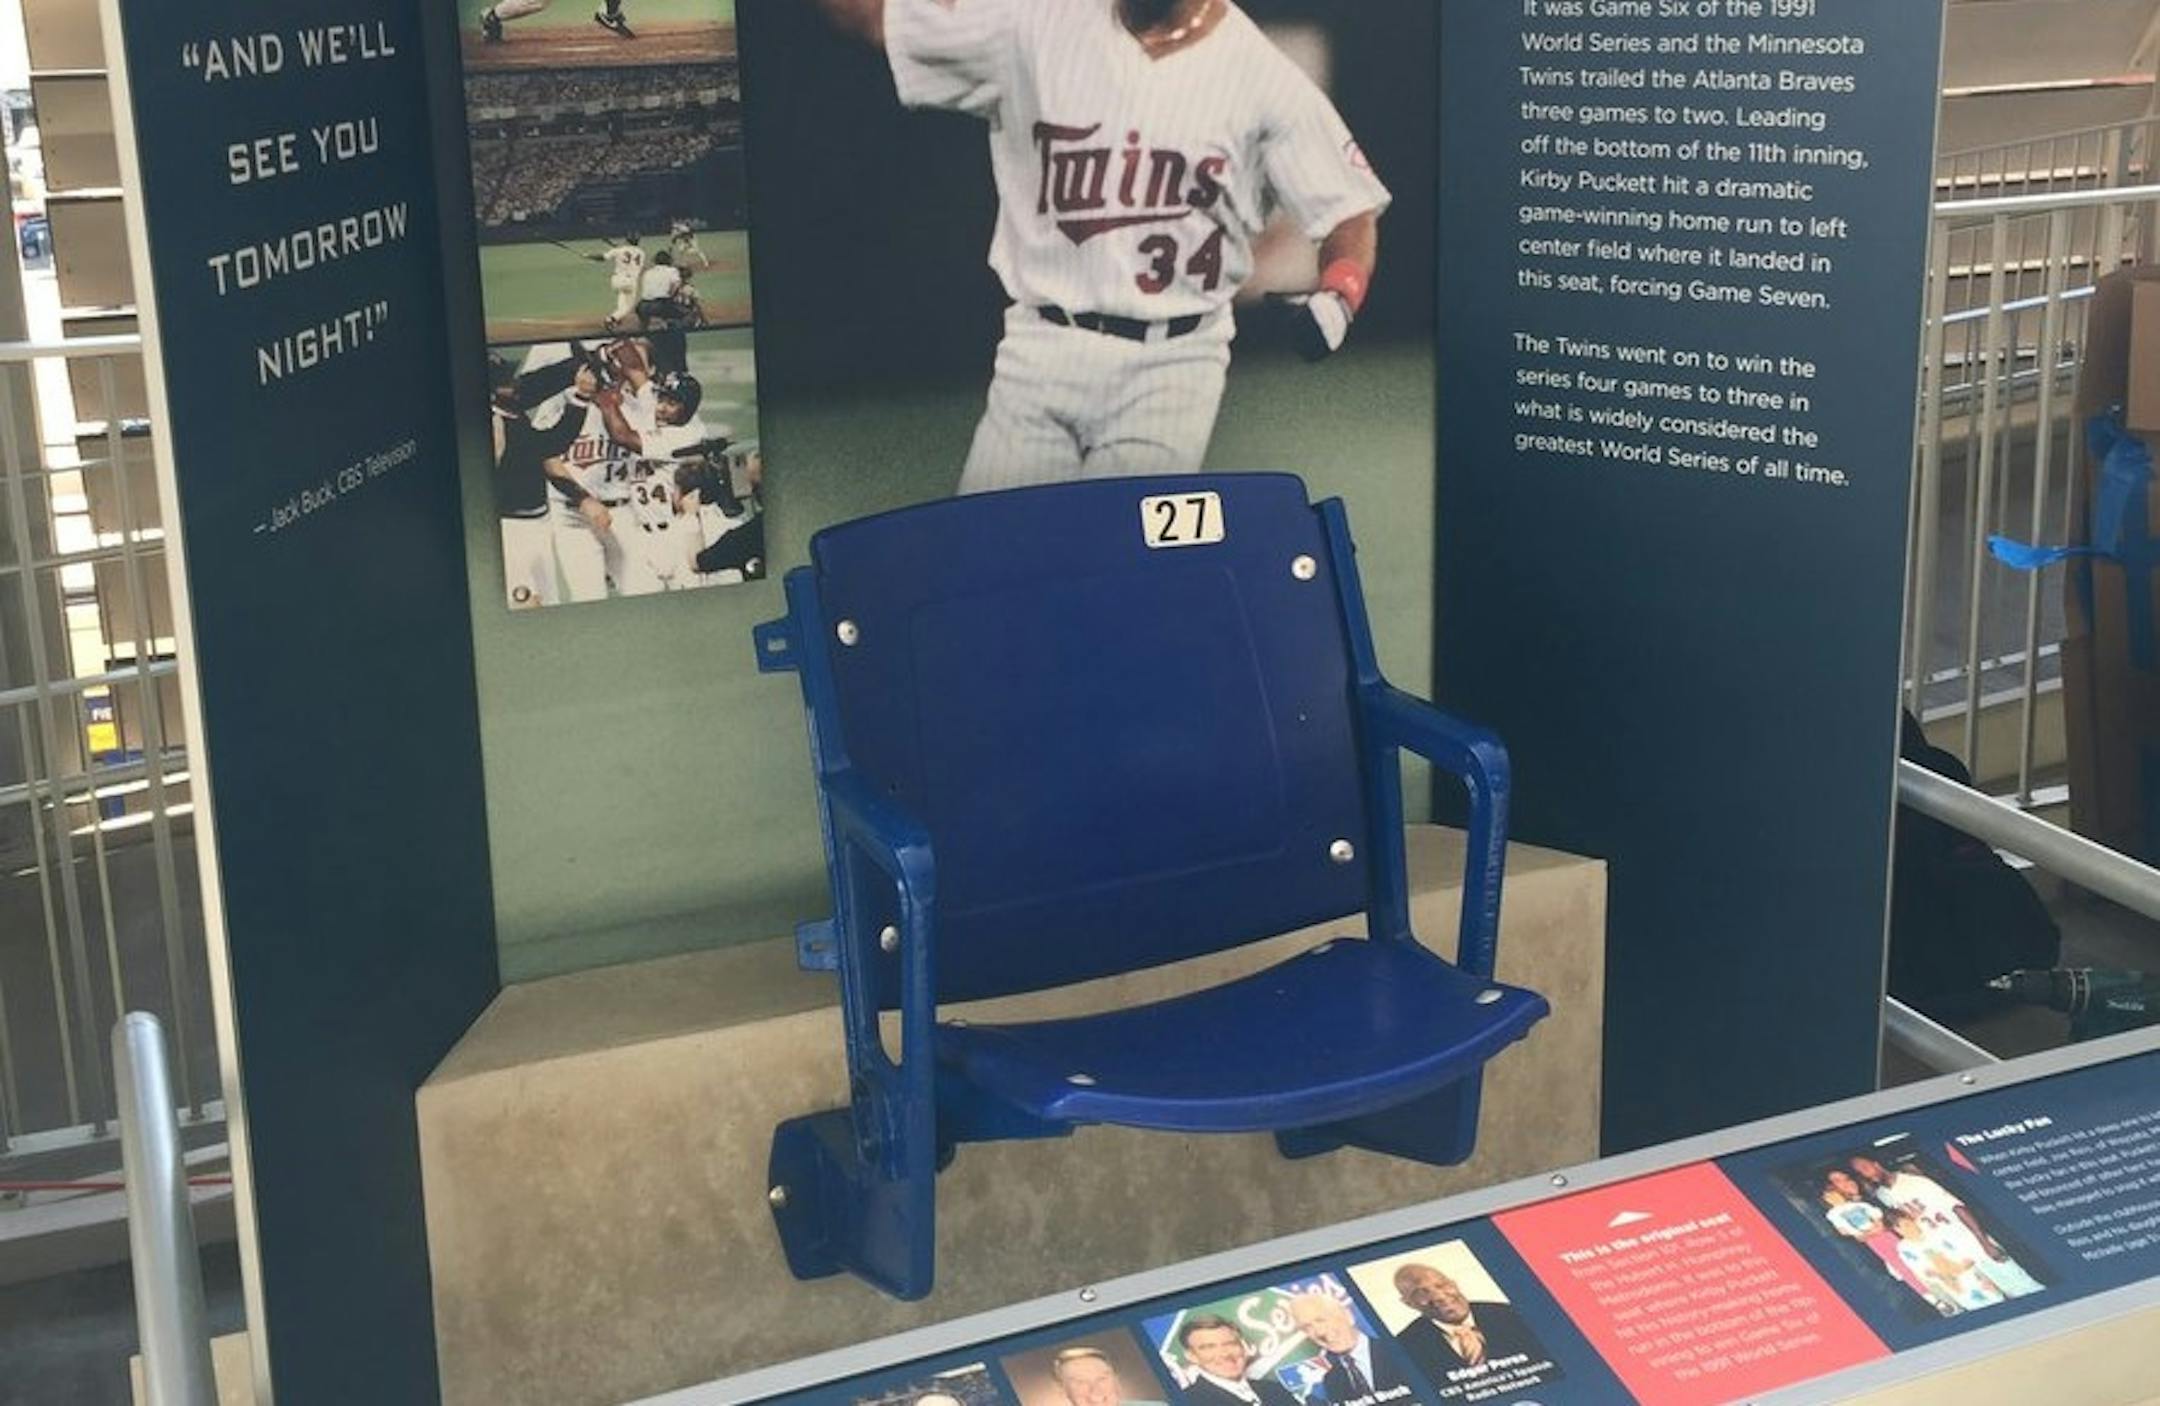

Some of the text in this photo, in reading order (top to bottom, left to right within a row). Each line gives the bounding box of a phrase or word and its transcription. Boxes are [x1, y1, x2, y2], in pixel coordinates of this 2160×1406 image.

[1523, 0, 1816, 17] It was Game Six of the 1991
[1521, 32, 1865, 55] World Series and the Minnesota
[1520, 66, 1856, 92] Twins trailed the Atlanta Braves
[1520, 102, 1826, 131] three games to two. Leading
[228, 116, 379, 185] SEE YOU
[1033, 121, 1226, 214] Twins
[1521, 136, 1869, 170] off the bottom of the 11th inning,
[1520, 169, 1813, 201] Kirby Puckett hit a dramatic
[1518, 205, 1848, 239] game-winning home run to left
[208, 201, 408, 296] TOMORROW
[1135, 228, 1223, 294] 34
[1518, 239, 1831, 274] center field where it landed in
[1518, 269, 1831, 309] this seat, forcing Game Seven.
[1514, 332, 1816, 379] The Twins went on to win the
[1515, 367, 1809, 412] series four games to three in
[1514, 400, 1819, 449] what is widely considered the
[604, 461, 628, 483] 14
[1514, 432, 1849, 487] greatest World Series of all time.
[270, 498, 300, 533] Jack
[337, 462, 363, 494] CBS
[365, 439, 417, 477] Television
[637, 484, 667, 505] 34
[1156, 498, 1206, 541] 27
[1955, 1116, 2052, 1147] The Lucky Fan
